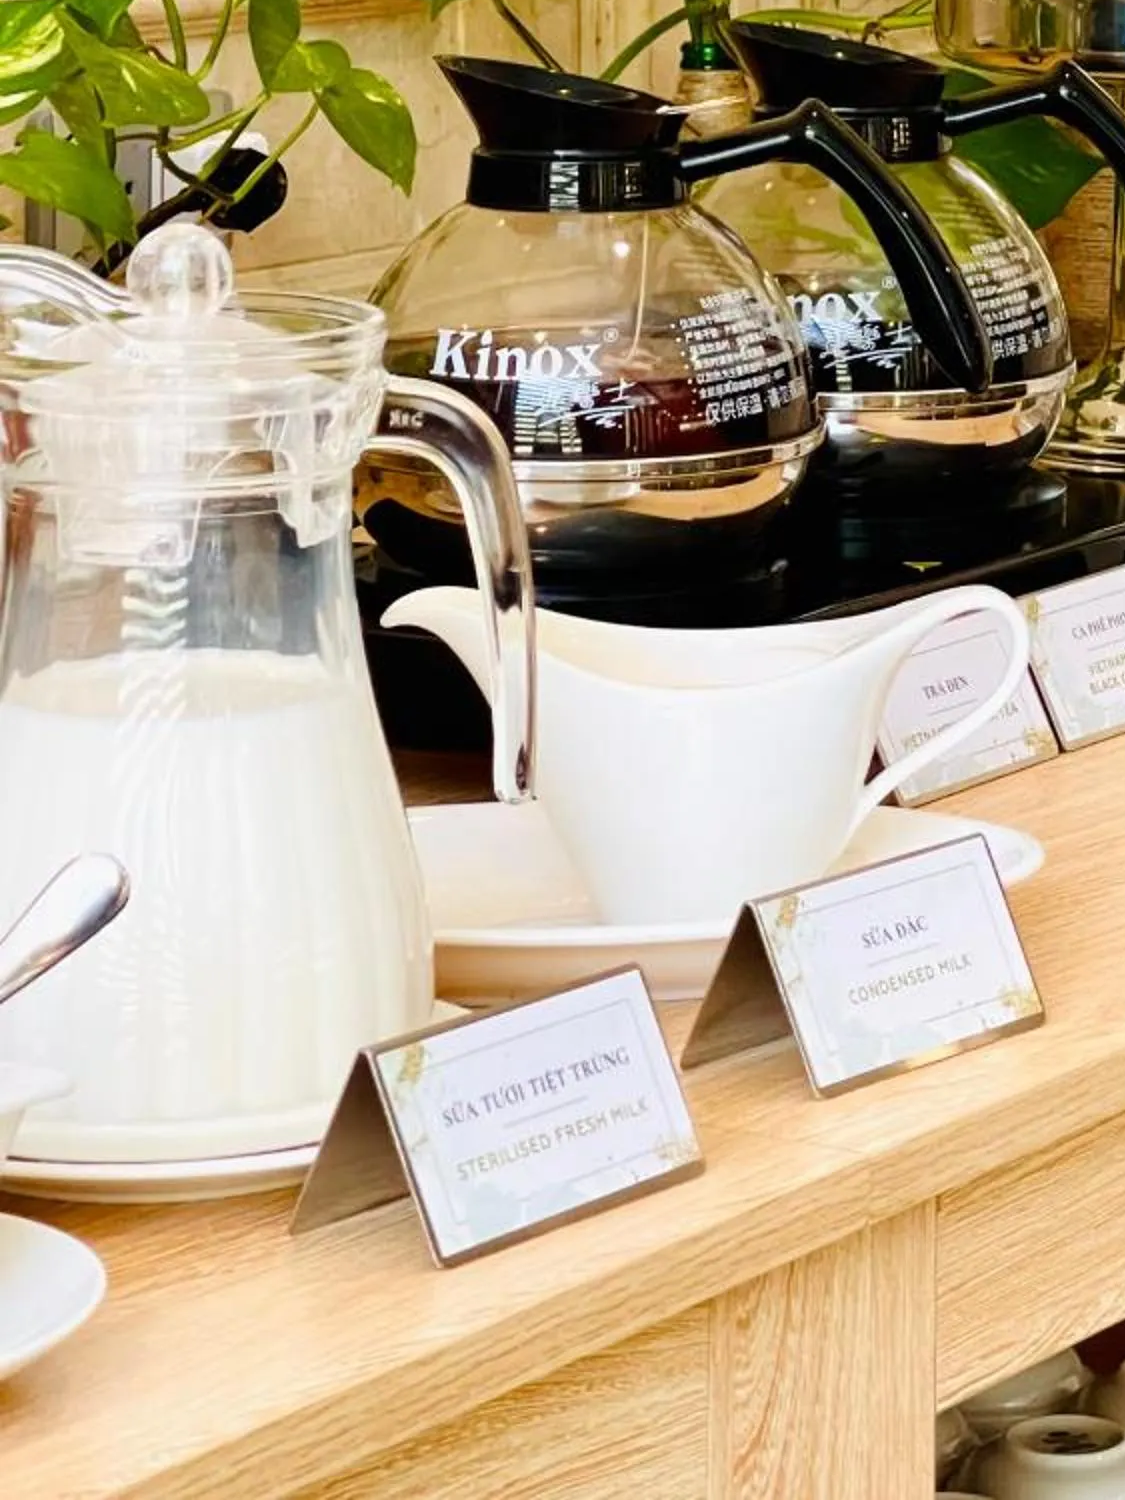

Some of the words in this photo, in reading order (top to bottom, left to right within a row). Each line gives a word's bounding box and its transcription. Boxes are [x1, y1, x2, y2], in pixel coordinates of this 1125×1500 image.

[786, 291, 883, 323] nox
[429, 327, 602, 380] Kinox
[849, 965, 935, 1005] CONDENSED
[938, 954, 972, 976] MILK
[456, 1132, 551, 1181] STERILISED
[554, 1111, 608, 1144] FRESH
[611, 1096, 649, 1122] MILK
